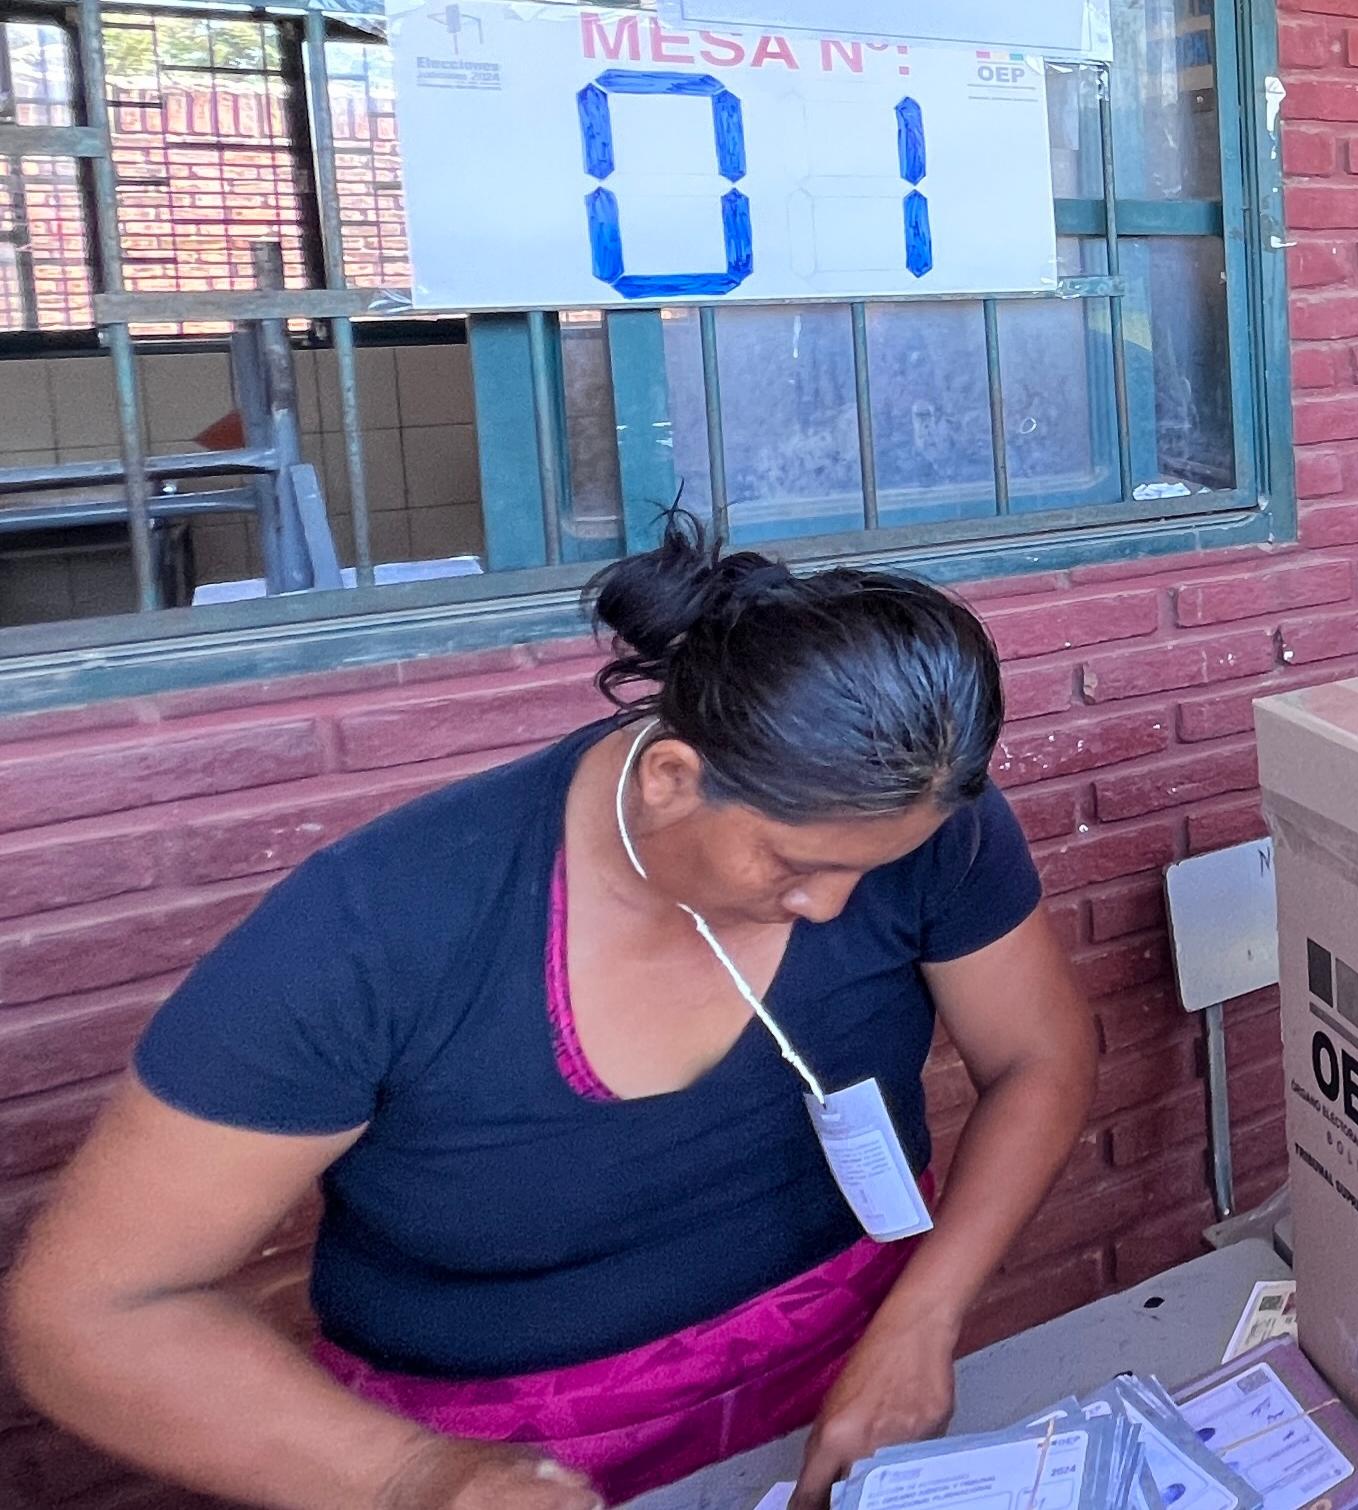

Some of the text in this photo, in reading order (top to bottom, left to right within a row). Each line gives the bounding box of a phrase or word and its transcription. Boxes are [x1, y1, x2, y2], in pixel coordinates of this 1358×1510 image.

[580, 12, 799, 70] MESA
[977, 65, 1025, 83] OEP
[576, 69, 933, 299] 01
[1294, 1142, 1334, 1187] TRIBUNAL
[1050, 1464, 1076, 1478] 2024
